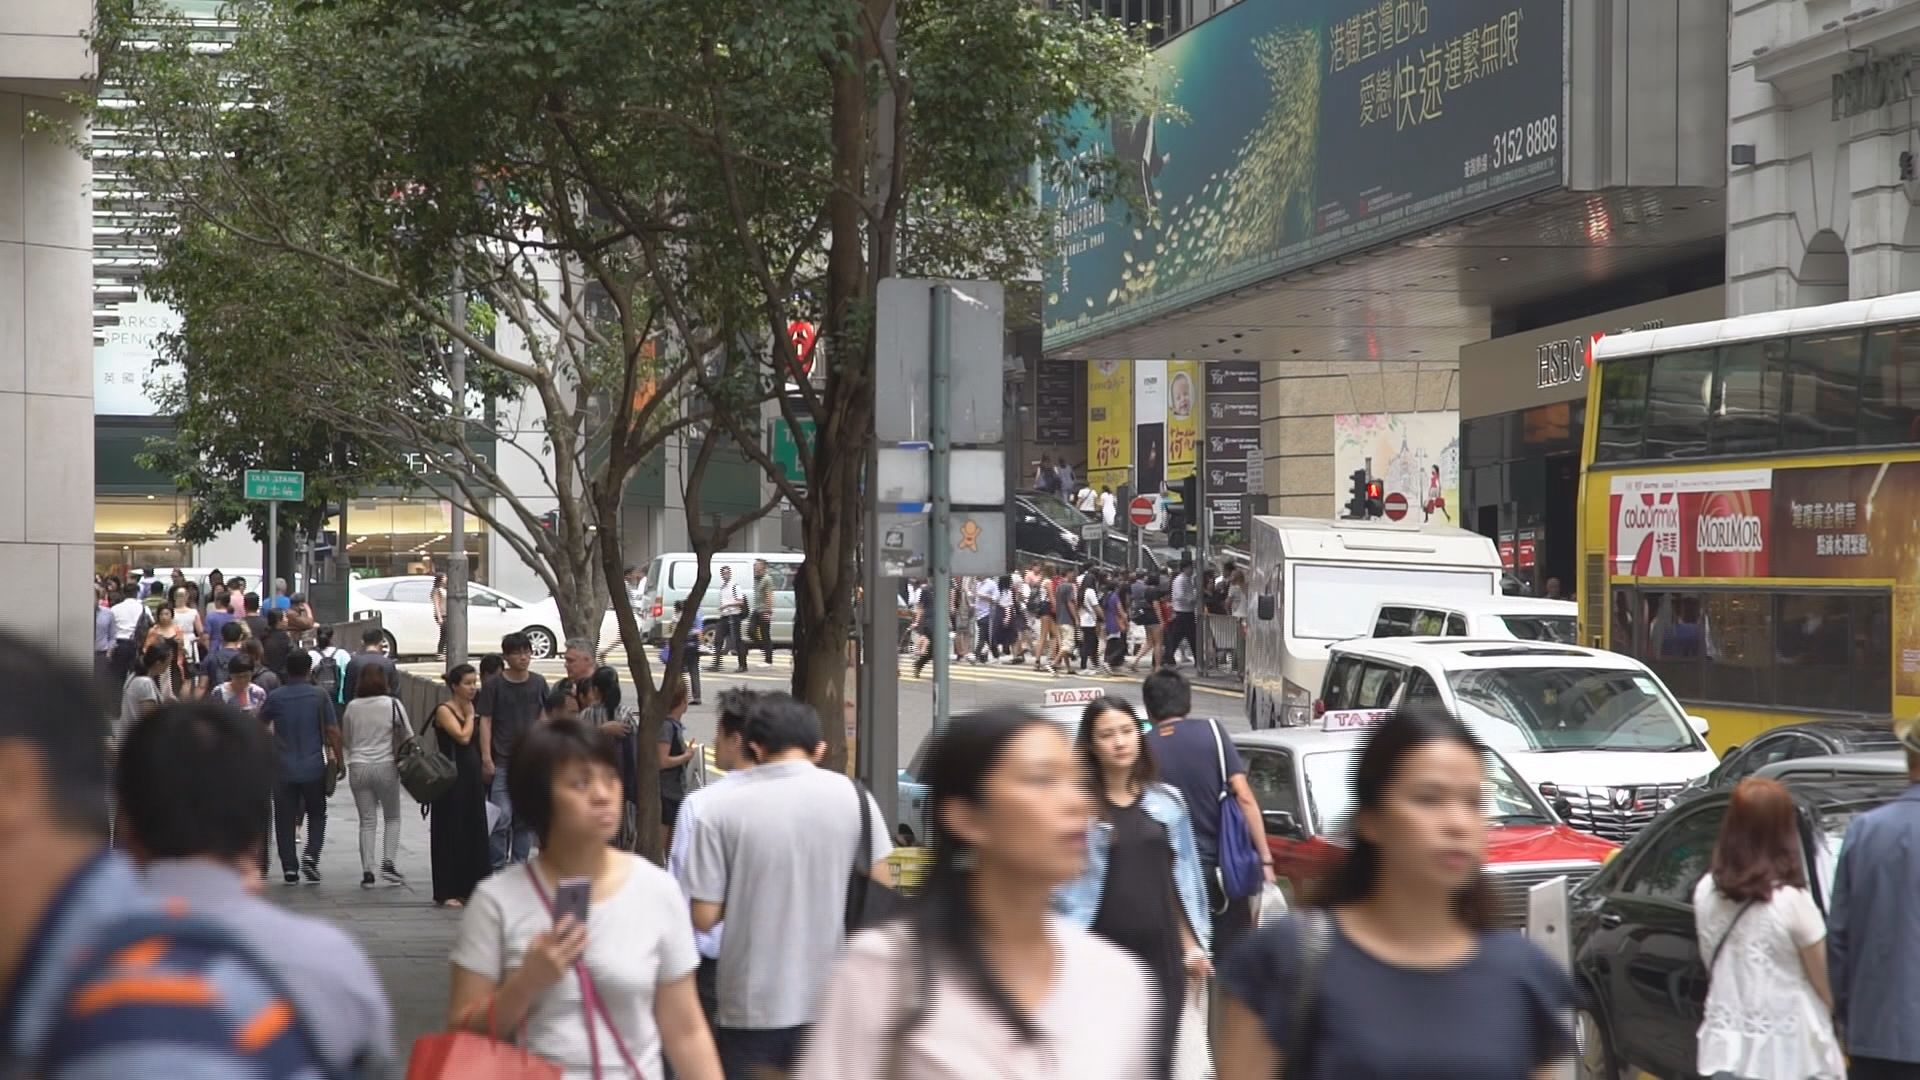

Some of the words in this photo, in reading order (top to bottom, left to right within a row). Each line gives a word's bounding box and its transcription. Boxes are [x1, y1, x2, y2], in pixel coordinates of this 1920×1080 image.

[1493, 126, 1523, 168] 3152
[1526, 114, 1557, 157] 8888
[119, 315, 158, 328] ARKS
[1537, 336, 1585, 389] HSBC
[1625, 505, 1678, 528] colourmix
[1051, 690, 1101, 703] TAXI
[1334, 711, 1388, 727] TAX
